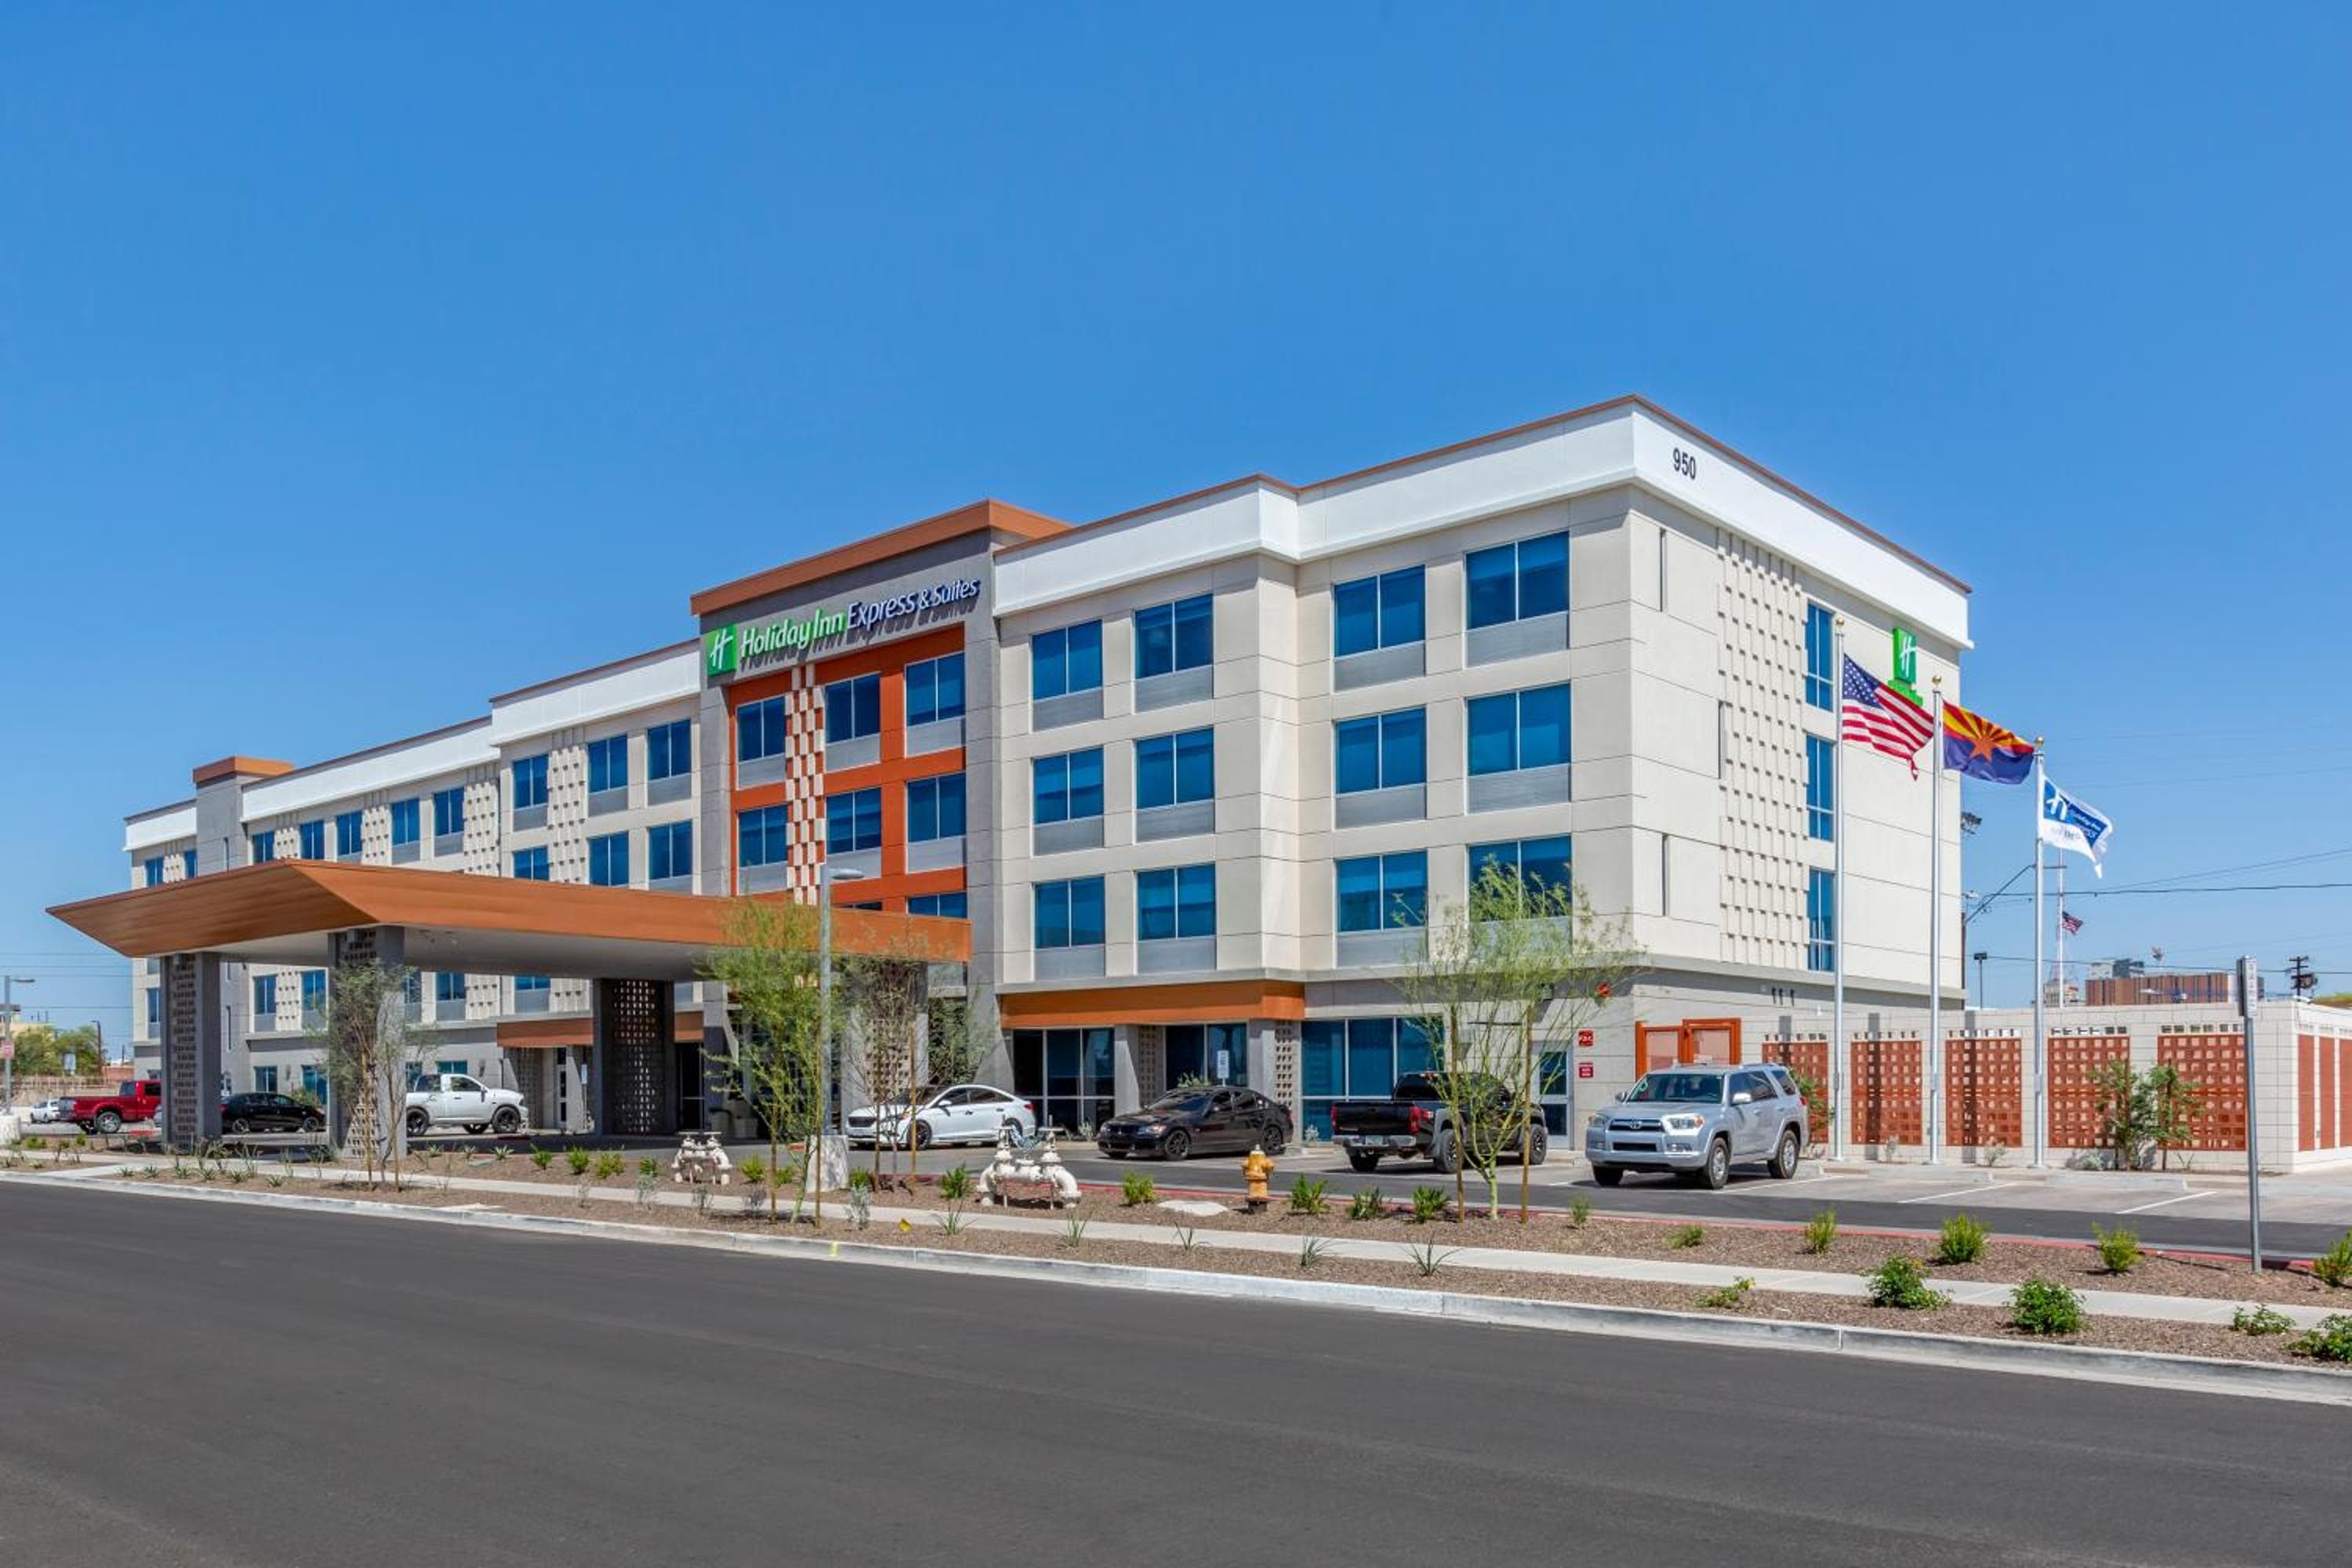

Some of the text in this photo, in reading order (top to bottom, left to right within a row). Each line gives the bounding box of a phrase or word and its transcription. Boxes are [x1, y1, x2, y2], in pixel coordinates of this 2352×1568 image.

[1673, 447, 1696, 481] 950
[740, 579, 979, 657] Holiday Inn Express & Suites
